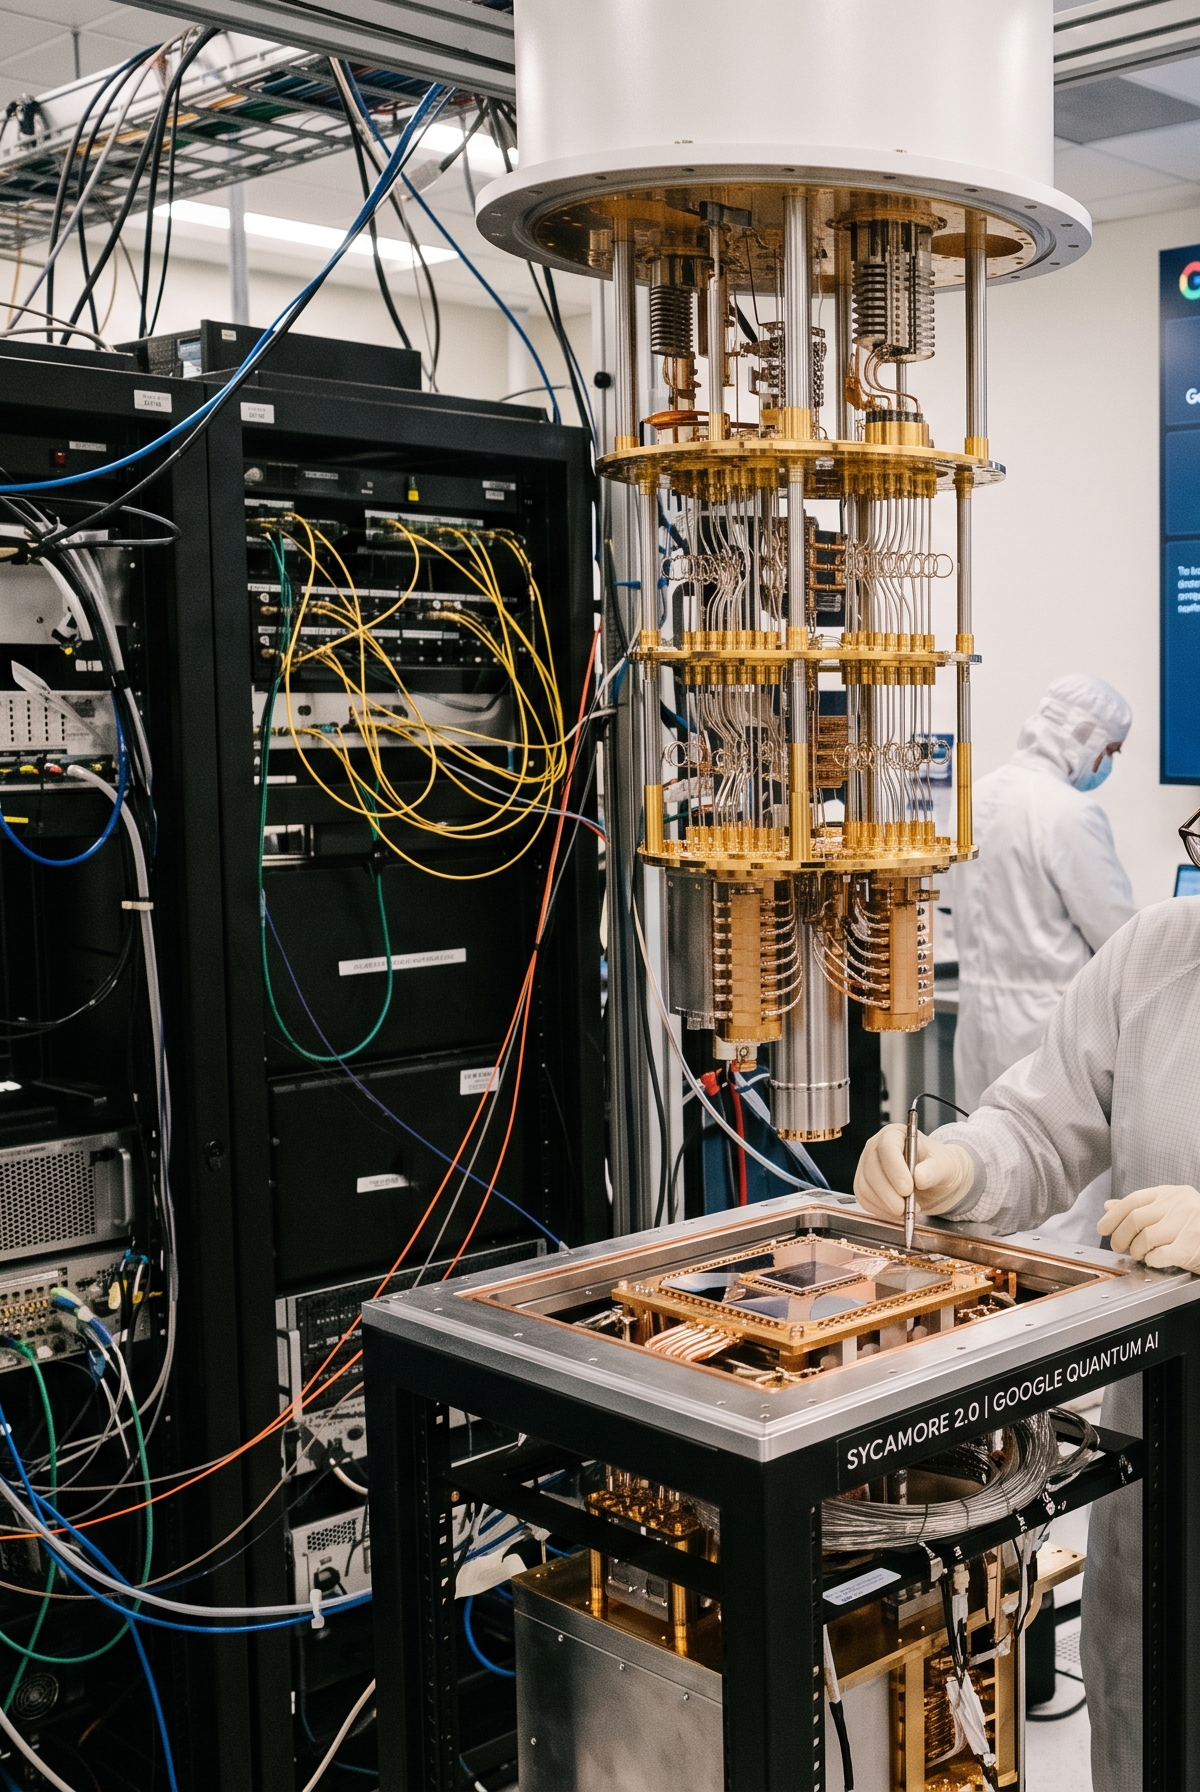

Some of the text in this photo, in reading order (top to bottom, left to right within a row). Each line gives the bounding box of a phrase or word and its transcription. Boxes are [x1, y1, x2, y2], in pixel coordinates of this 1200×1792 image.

[846, 1413, 950, 1471] SYCAMORE
[954, 1402, 979, 1429] 2.0
[992, 1369, 1063, 1412] GOOGLE
[1066, 1339, 1142, 1383] QUANTUM
[1144, 1331, 1159, 1353] AI
